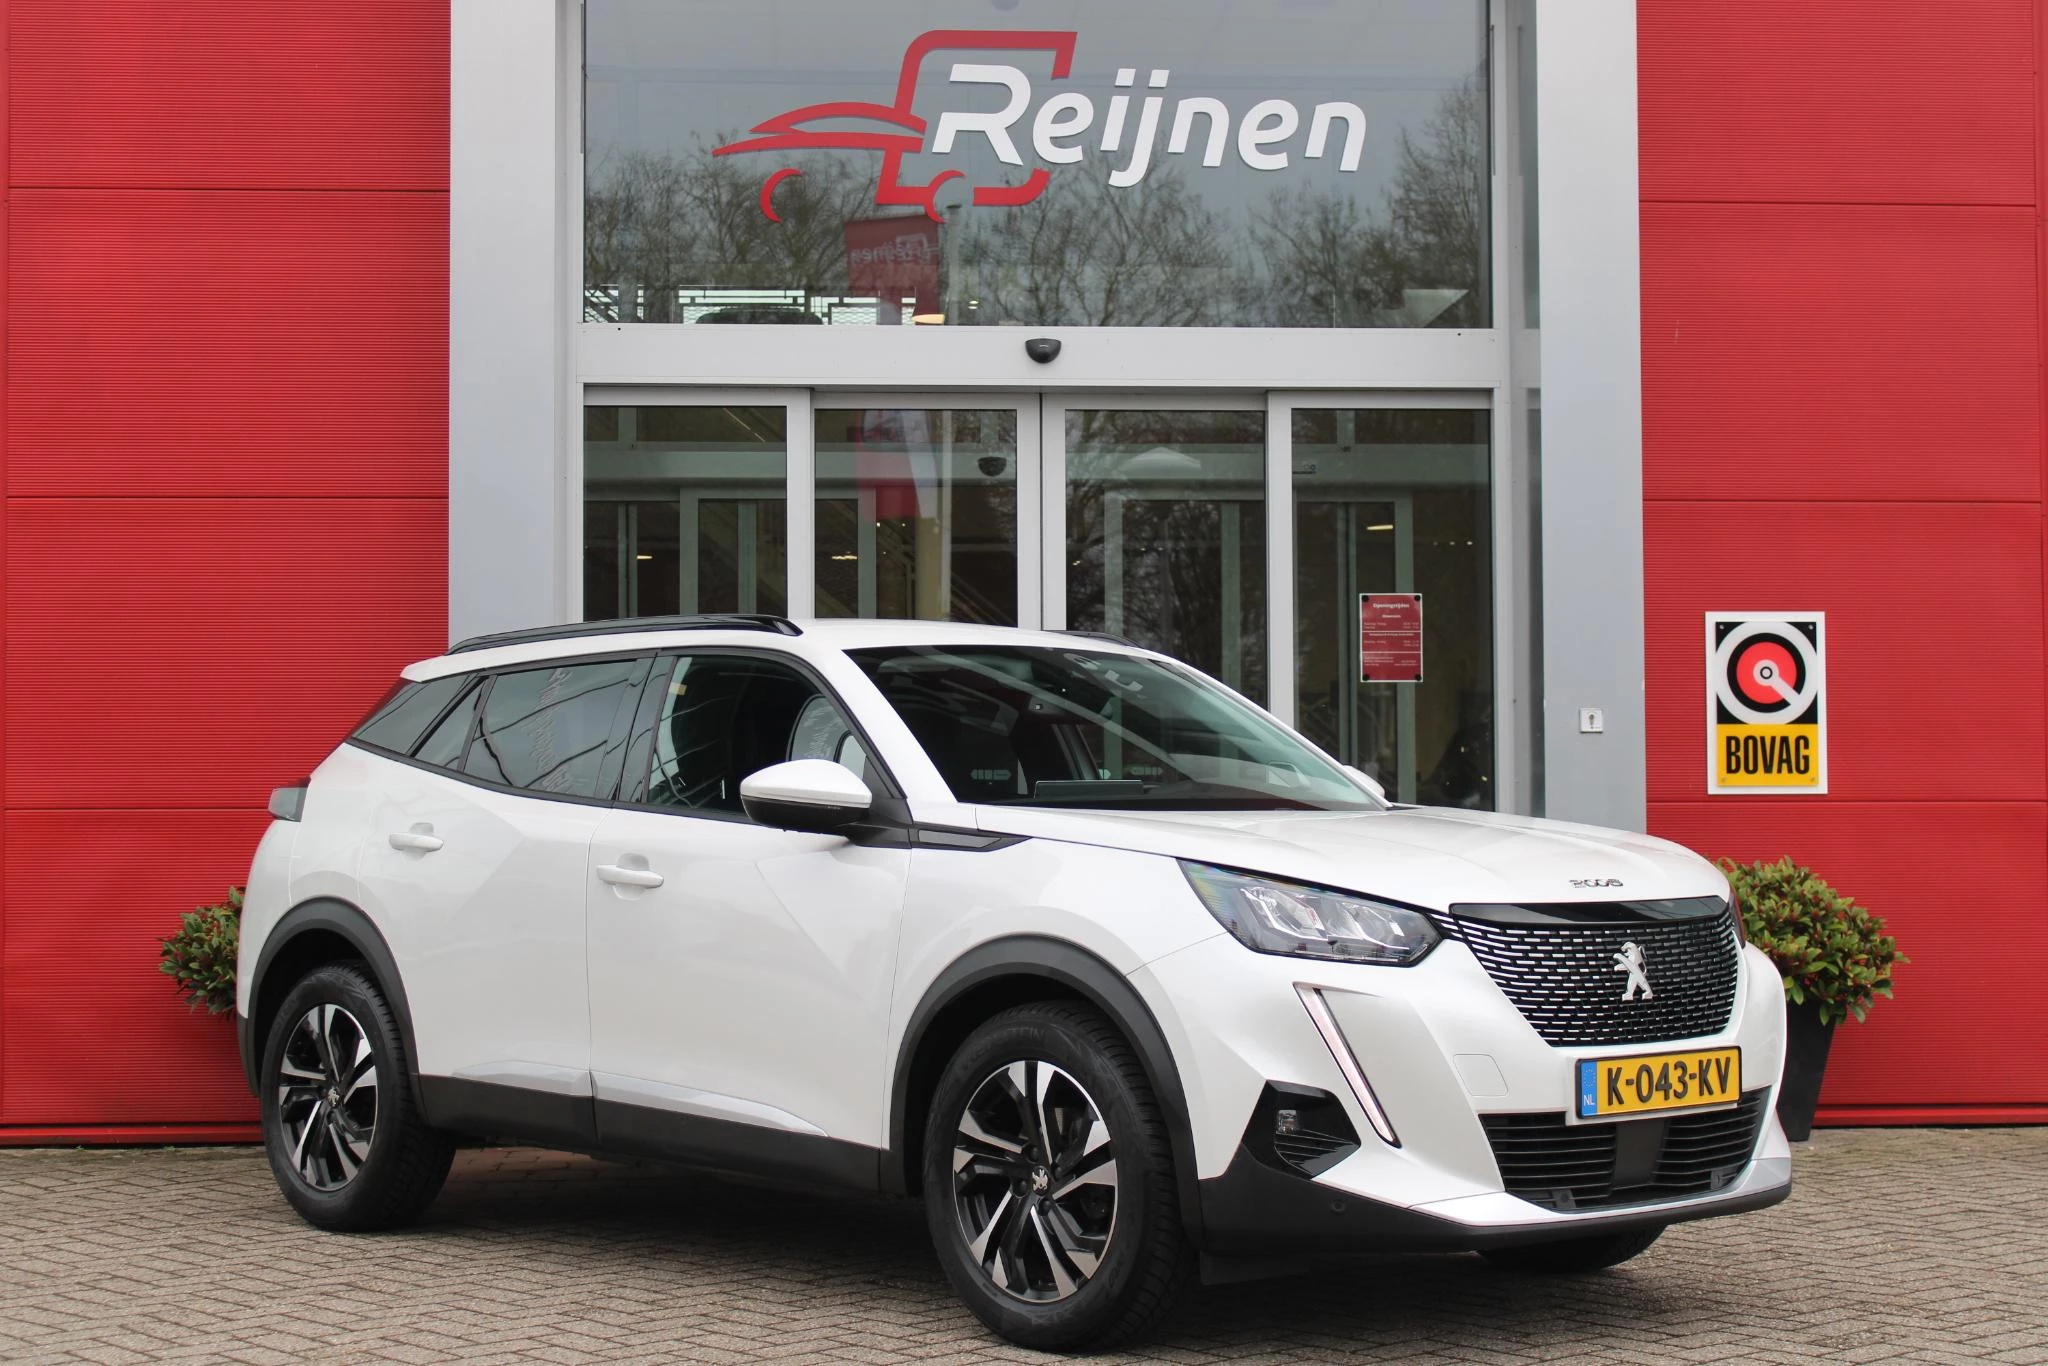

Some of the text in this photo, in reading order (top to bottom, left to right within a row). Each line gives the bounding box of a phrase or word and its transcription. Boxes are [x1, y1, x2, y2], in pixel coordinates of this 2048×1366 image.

[931, 63, 1367, 188] Reijnen
[1726, 735, 1810, 775] BOVAG
[1569, 878, 1624, 888] 2008
[1583, 1094, 1596, 1107] NL
[1607, 1056, 1731, 1106] K-043-KV
